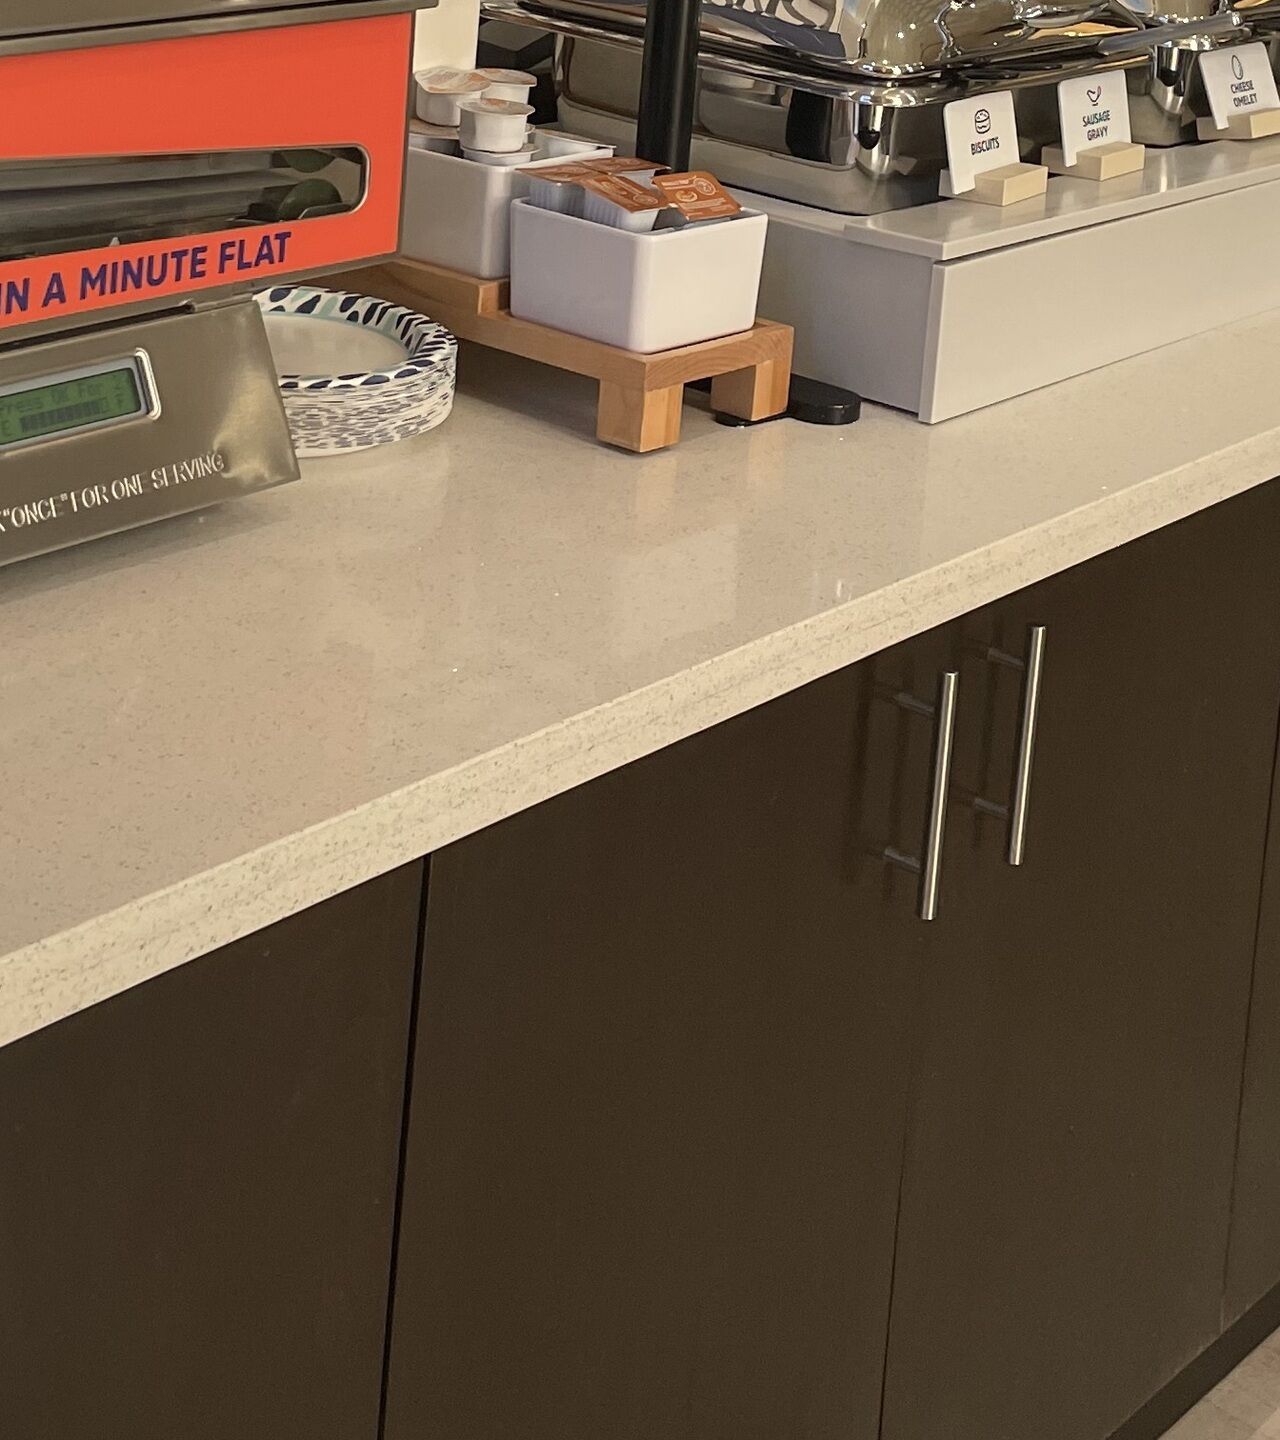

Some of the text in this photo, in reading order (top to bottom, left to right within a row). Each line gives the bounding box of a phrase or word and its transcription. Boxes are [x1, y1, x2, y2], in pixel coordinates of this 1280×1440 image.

[1230, 80, 1255, 94] CHEESE
[1233, 93, 1258, 107] OMELET
[1082, 110, 1111, 128] SAUSAGE
[1087, 126, 1109, 141] GRAVY
[970, 137, 1000, 156] BISCUITS
[42, 272, 67, 308] A
[79, 245, 208, 301] MINUTE
[218, 230, 293, 273] FLAT
[111, 471, 150, 503] ONE
[151, 452, 226, 491] SERVING
